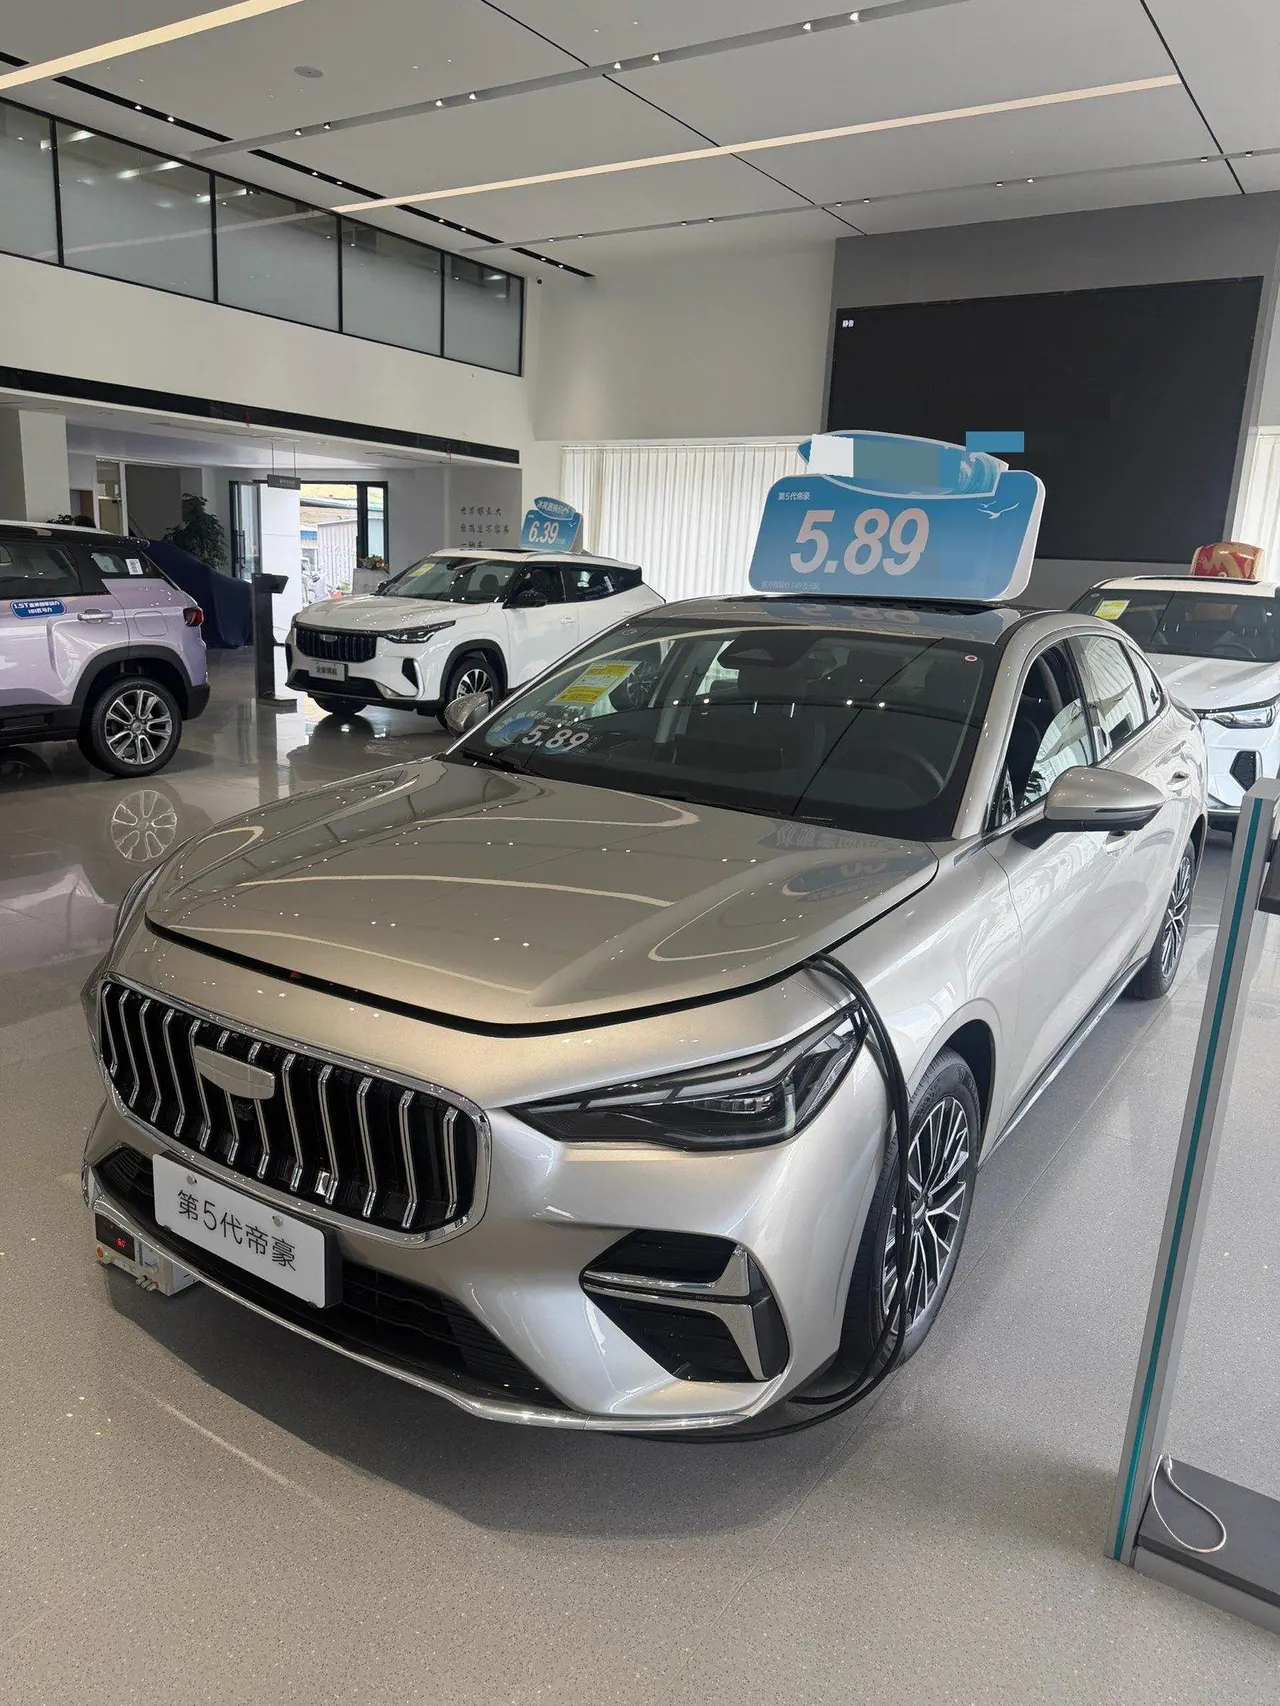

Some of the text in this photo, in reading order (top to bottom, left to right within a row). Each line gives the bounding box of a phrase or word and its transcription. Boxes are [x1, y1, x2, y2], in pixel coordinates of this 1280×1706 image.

[529, 521, 559, 545] 6.39
[790, 508, 930, 576] 5.89
[177, 1189, 297, 1272] 第5代帝豪
